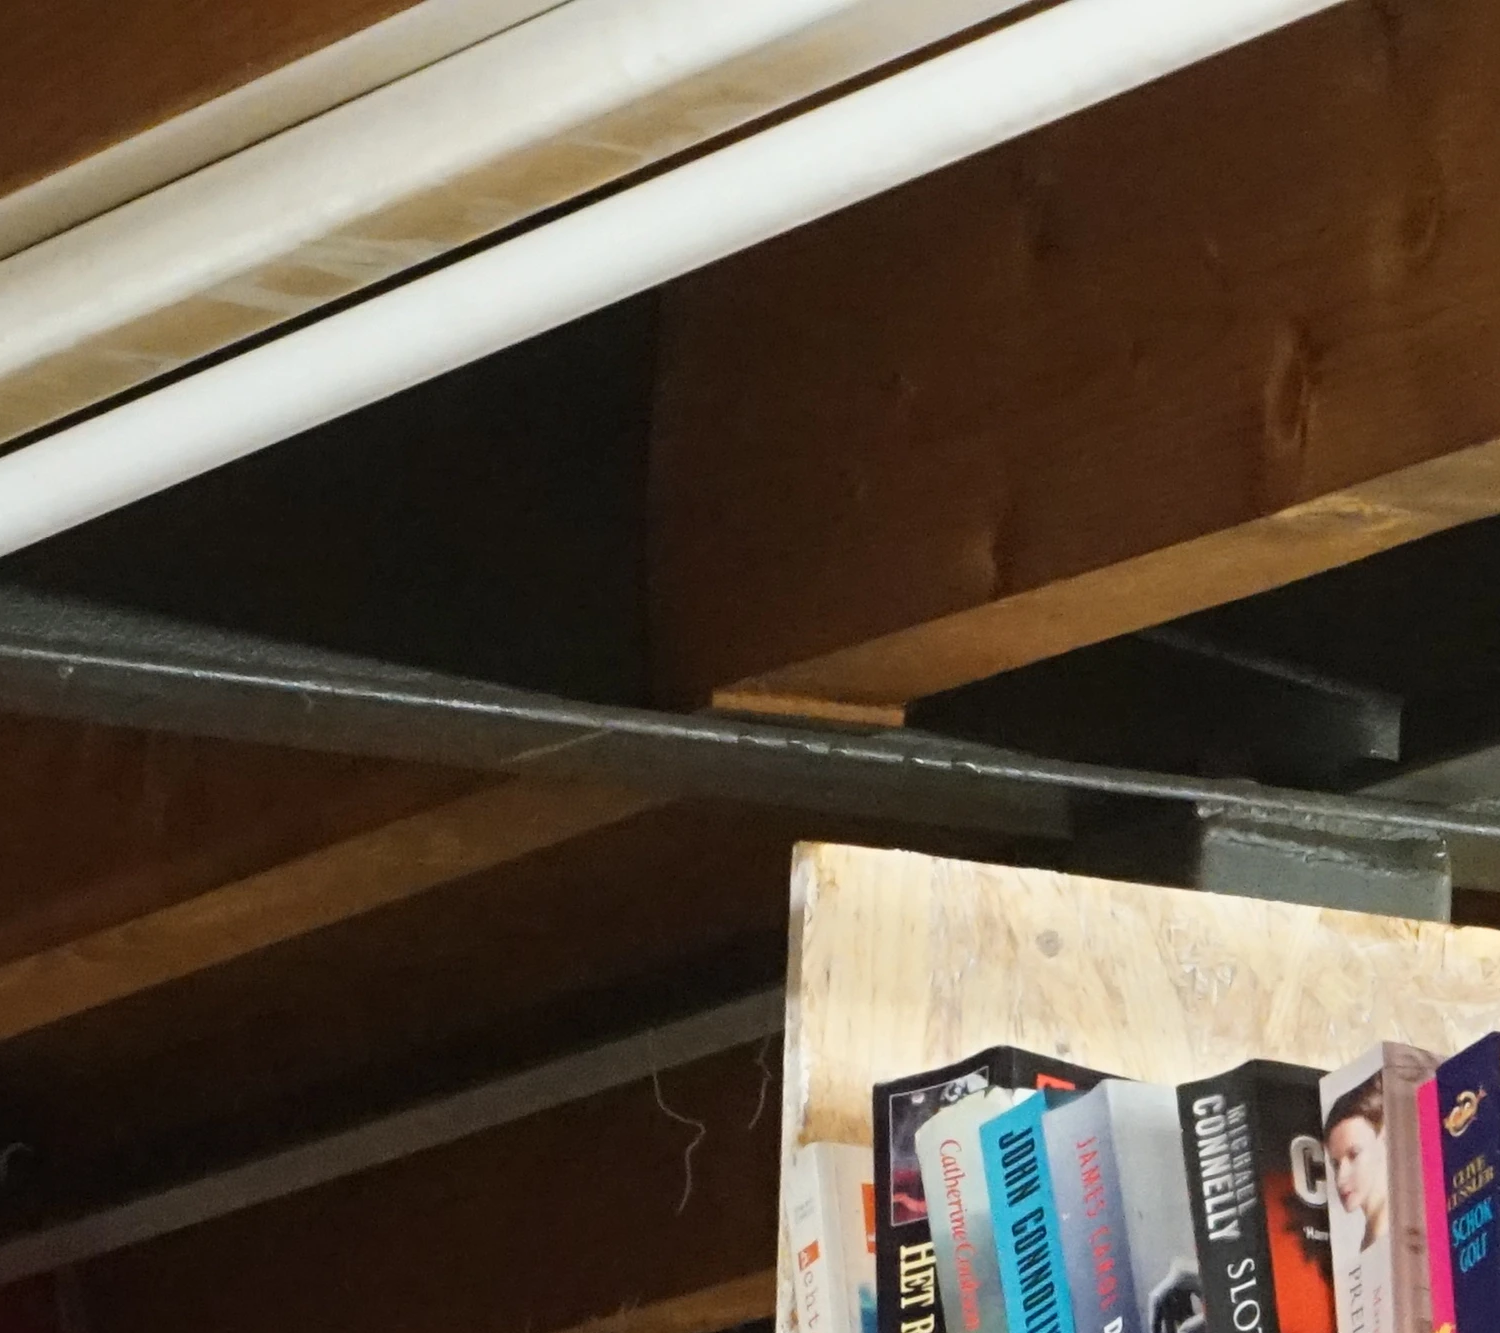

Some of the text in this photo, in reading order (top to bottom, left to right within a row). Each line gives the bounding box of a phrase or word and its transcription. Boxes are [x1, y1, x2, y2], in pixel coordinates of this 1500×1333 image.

[998, 1128, 1034, 1207] JOHN
[1192, 1096, 1240, 1241] CONNELLY
[1453, 1198, 1493, 1247] SCHOK
[900, 1242, 936, 1310] HET
